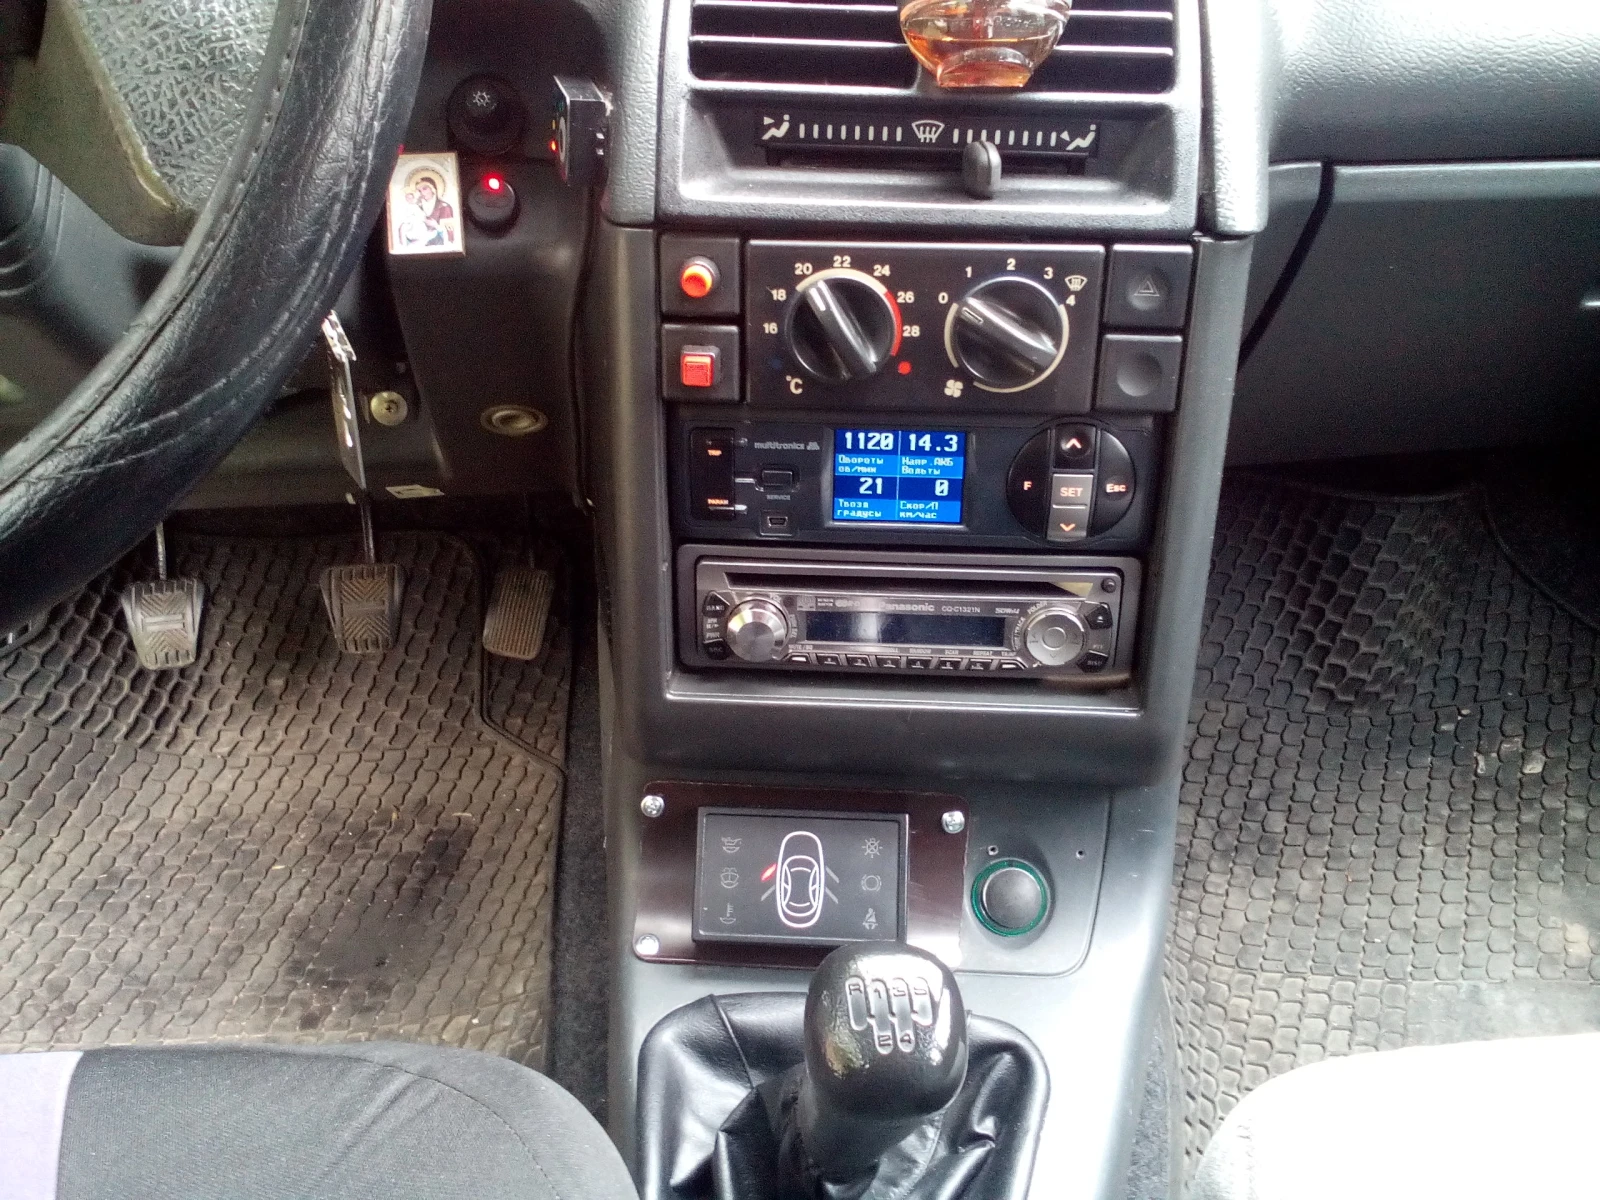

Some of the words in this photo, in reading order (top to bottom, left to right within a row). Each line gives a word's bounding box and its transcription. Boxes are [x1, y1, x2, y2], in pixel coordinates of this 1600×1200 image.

[833, 255, 851, 267] 22
[1006, 258, 1016, 271] 2
[794, 263, 813, 275] 20
[873, 265, 891, 277] 24
[965, 266, 972, 278] 1
[1043, 267, 1053, 279] 3
[772, 289, 787, 301] 18
[897, 291, 915, 303] 26
[938, 292, 949, 304] 0
[1065, 295, 1076, 306] 4
[763, 323, 778, 334] 16
[902, 326, 920, 337] 28
[845, 432, 894, 450] 1120
[909, 433, 958, 452] 14.3
[901, 465, 941, 475] Вольты
[859, 477, 883, 494] 21
[934, 479, 949, 496] 0
[1023, 481, 1032, 490] F
[1105, 483, 1126, 493] Esc
[1060, 487, 1083, 497] SET
[879, 602, 935, 611] Panasonic
